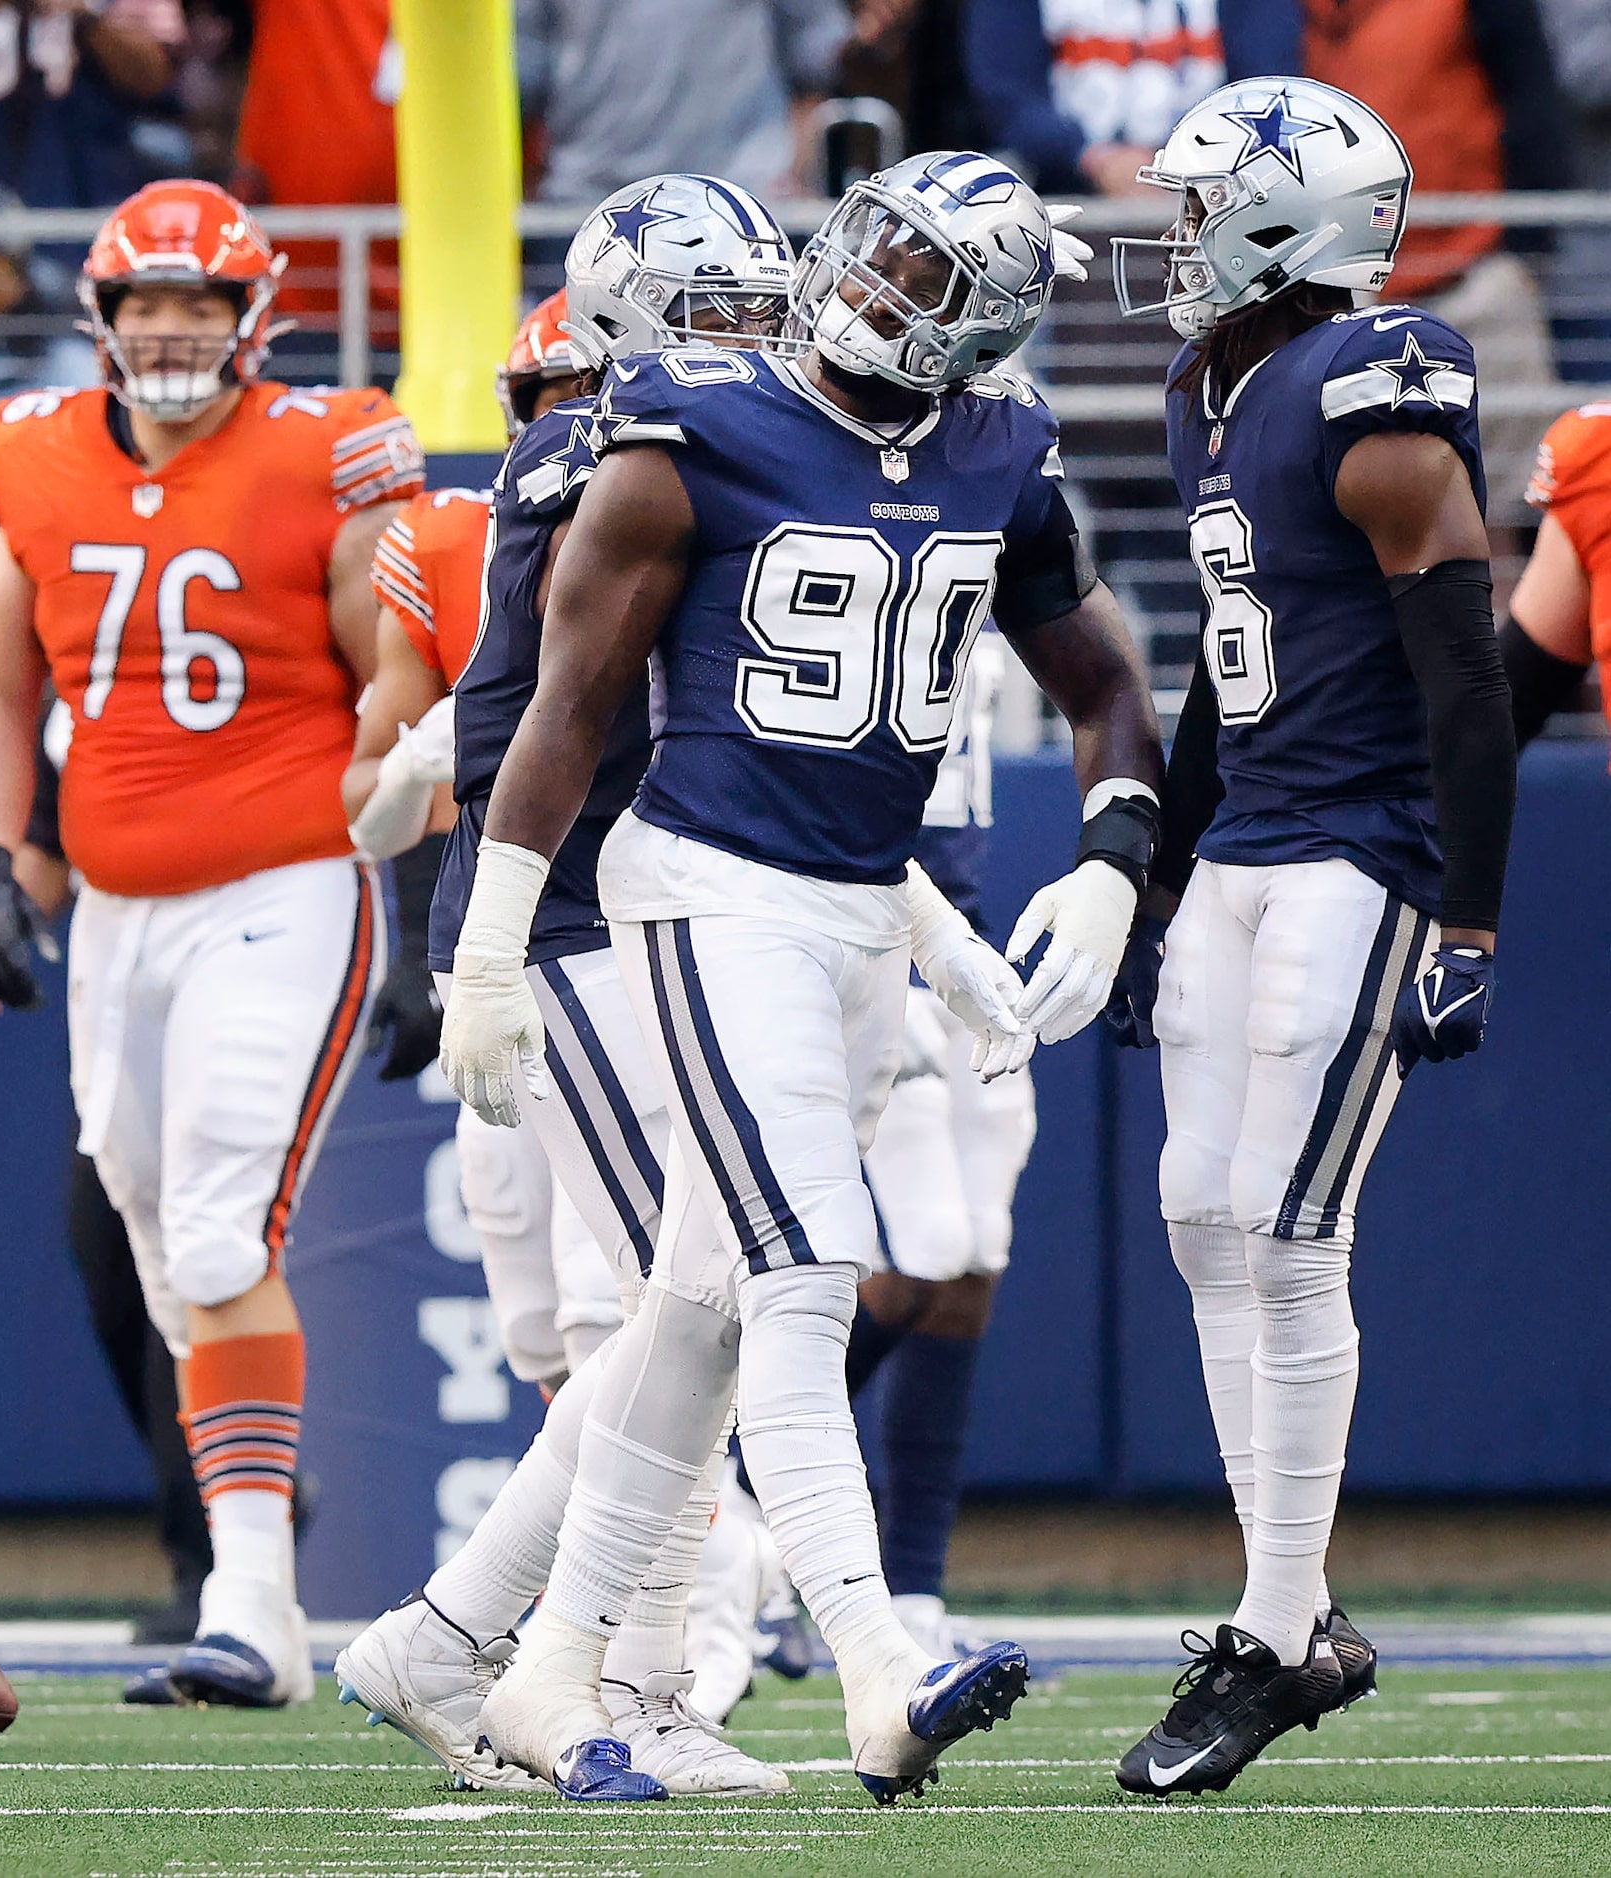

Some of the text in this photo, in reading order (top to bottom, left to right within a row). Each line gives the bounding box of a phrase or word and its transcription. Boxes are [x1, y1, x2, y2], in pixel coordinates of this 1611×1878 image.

[870, 503, 940, 521] COWBOYS
[1188, 498, 1277, 727] 6
[71, 542, 246, 733] 76
[734, 521, 1006, 753] 90
